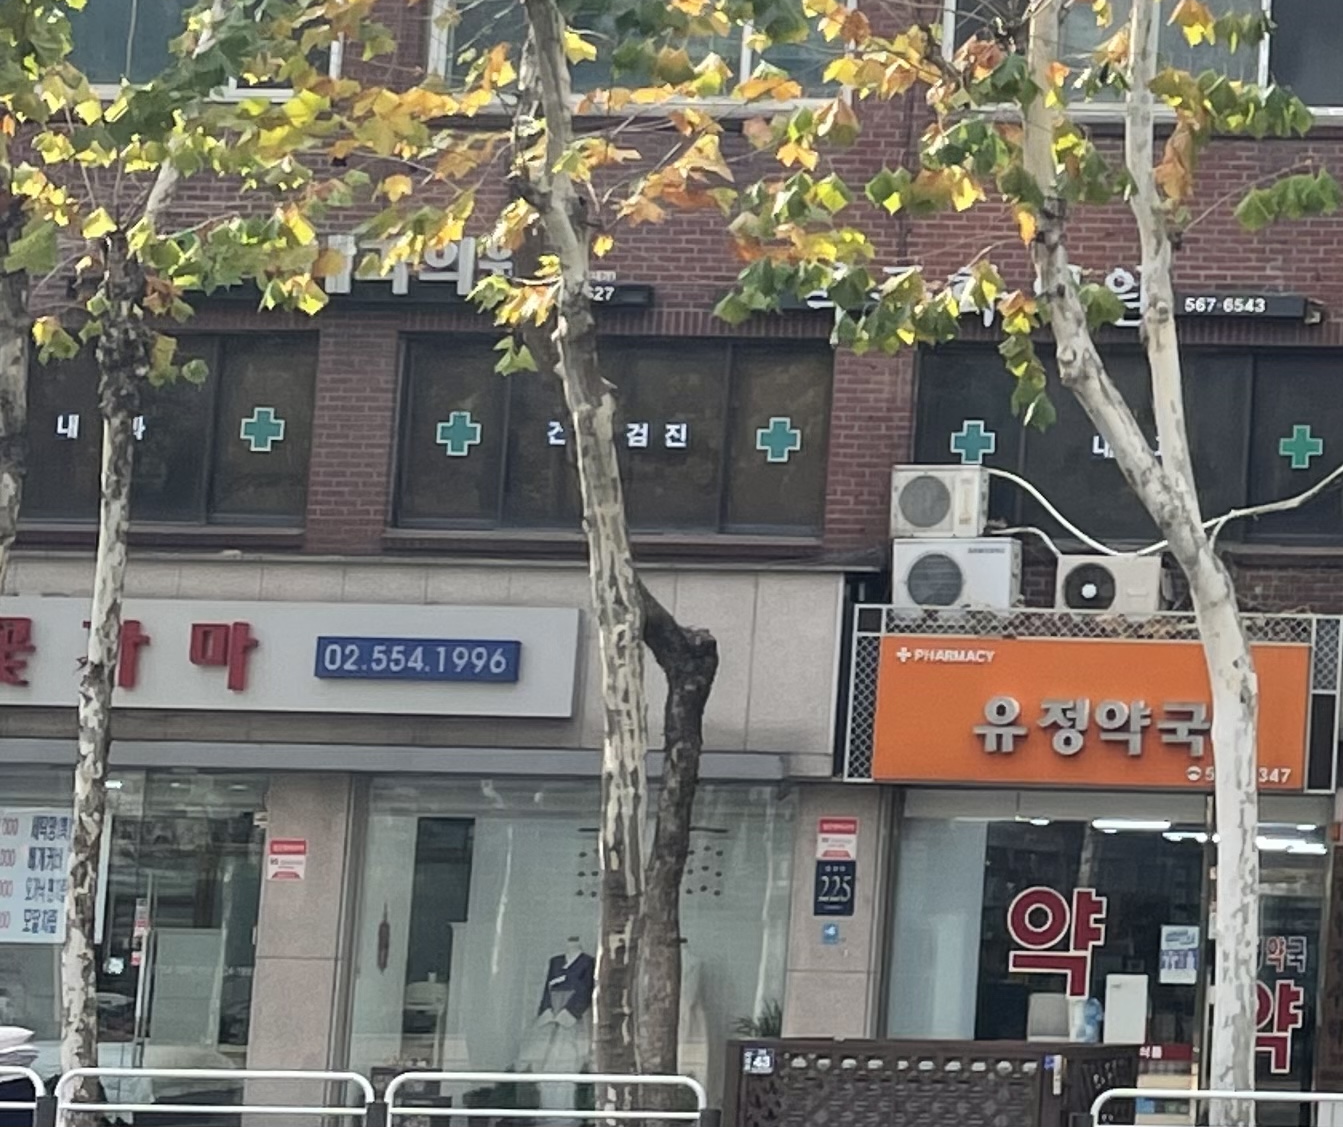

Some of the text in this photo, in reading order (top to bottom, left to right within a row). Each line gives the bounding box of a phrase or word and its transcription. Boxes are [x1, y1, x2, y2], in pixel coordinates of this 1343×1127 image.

[323, 643, 508, 675] 02.554.1996
[914, 648, 996, 664] PHARMACY
[973, 695, 1211, 758] 유정약국
[818, 875, 852, 903] 225
[1008, 885, 1106, 998] 약
